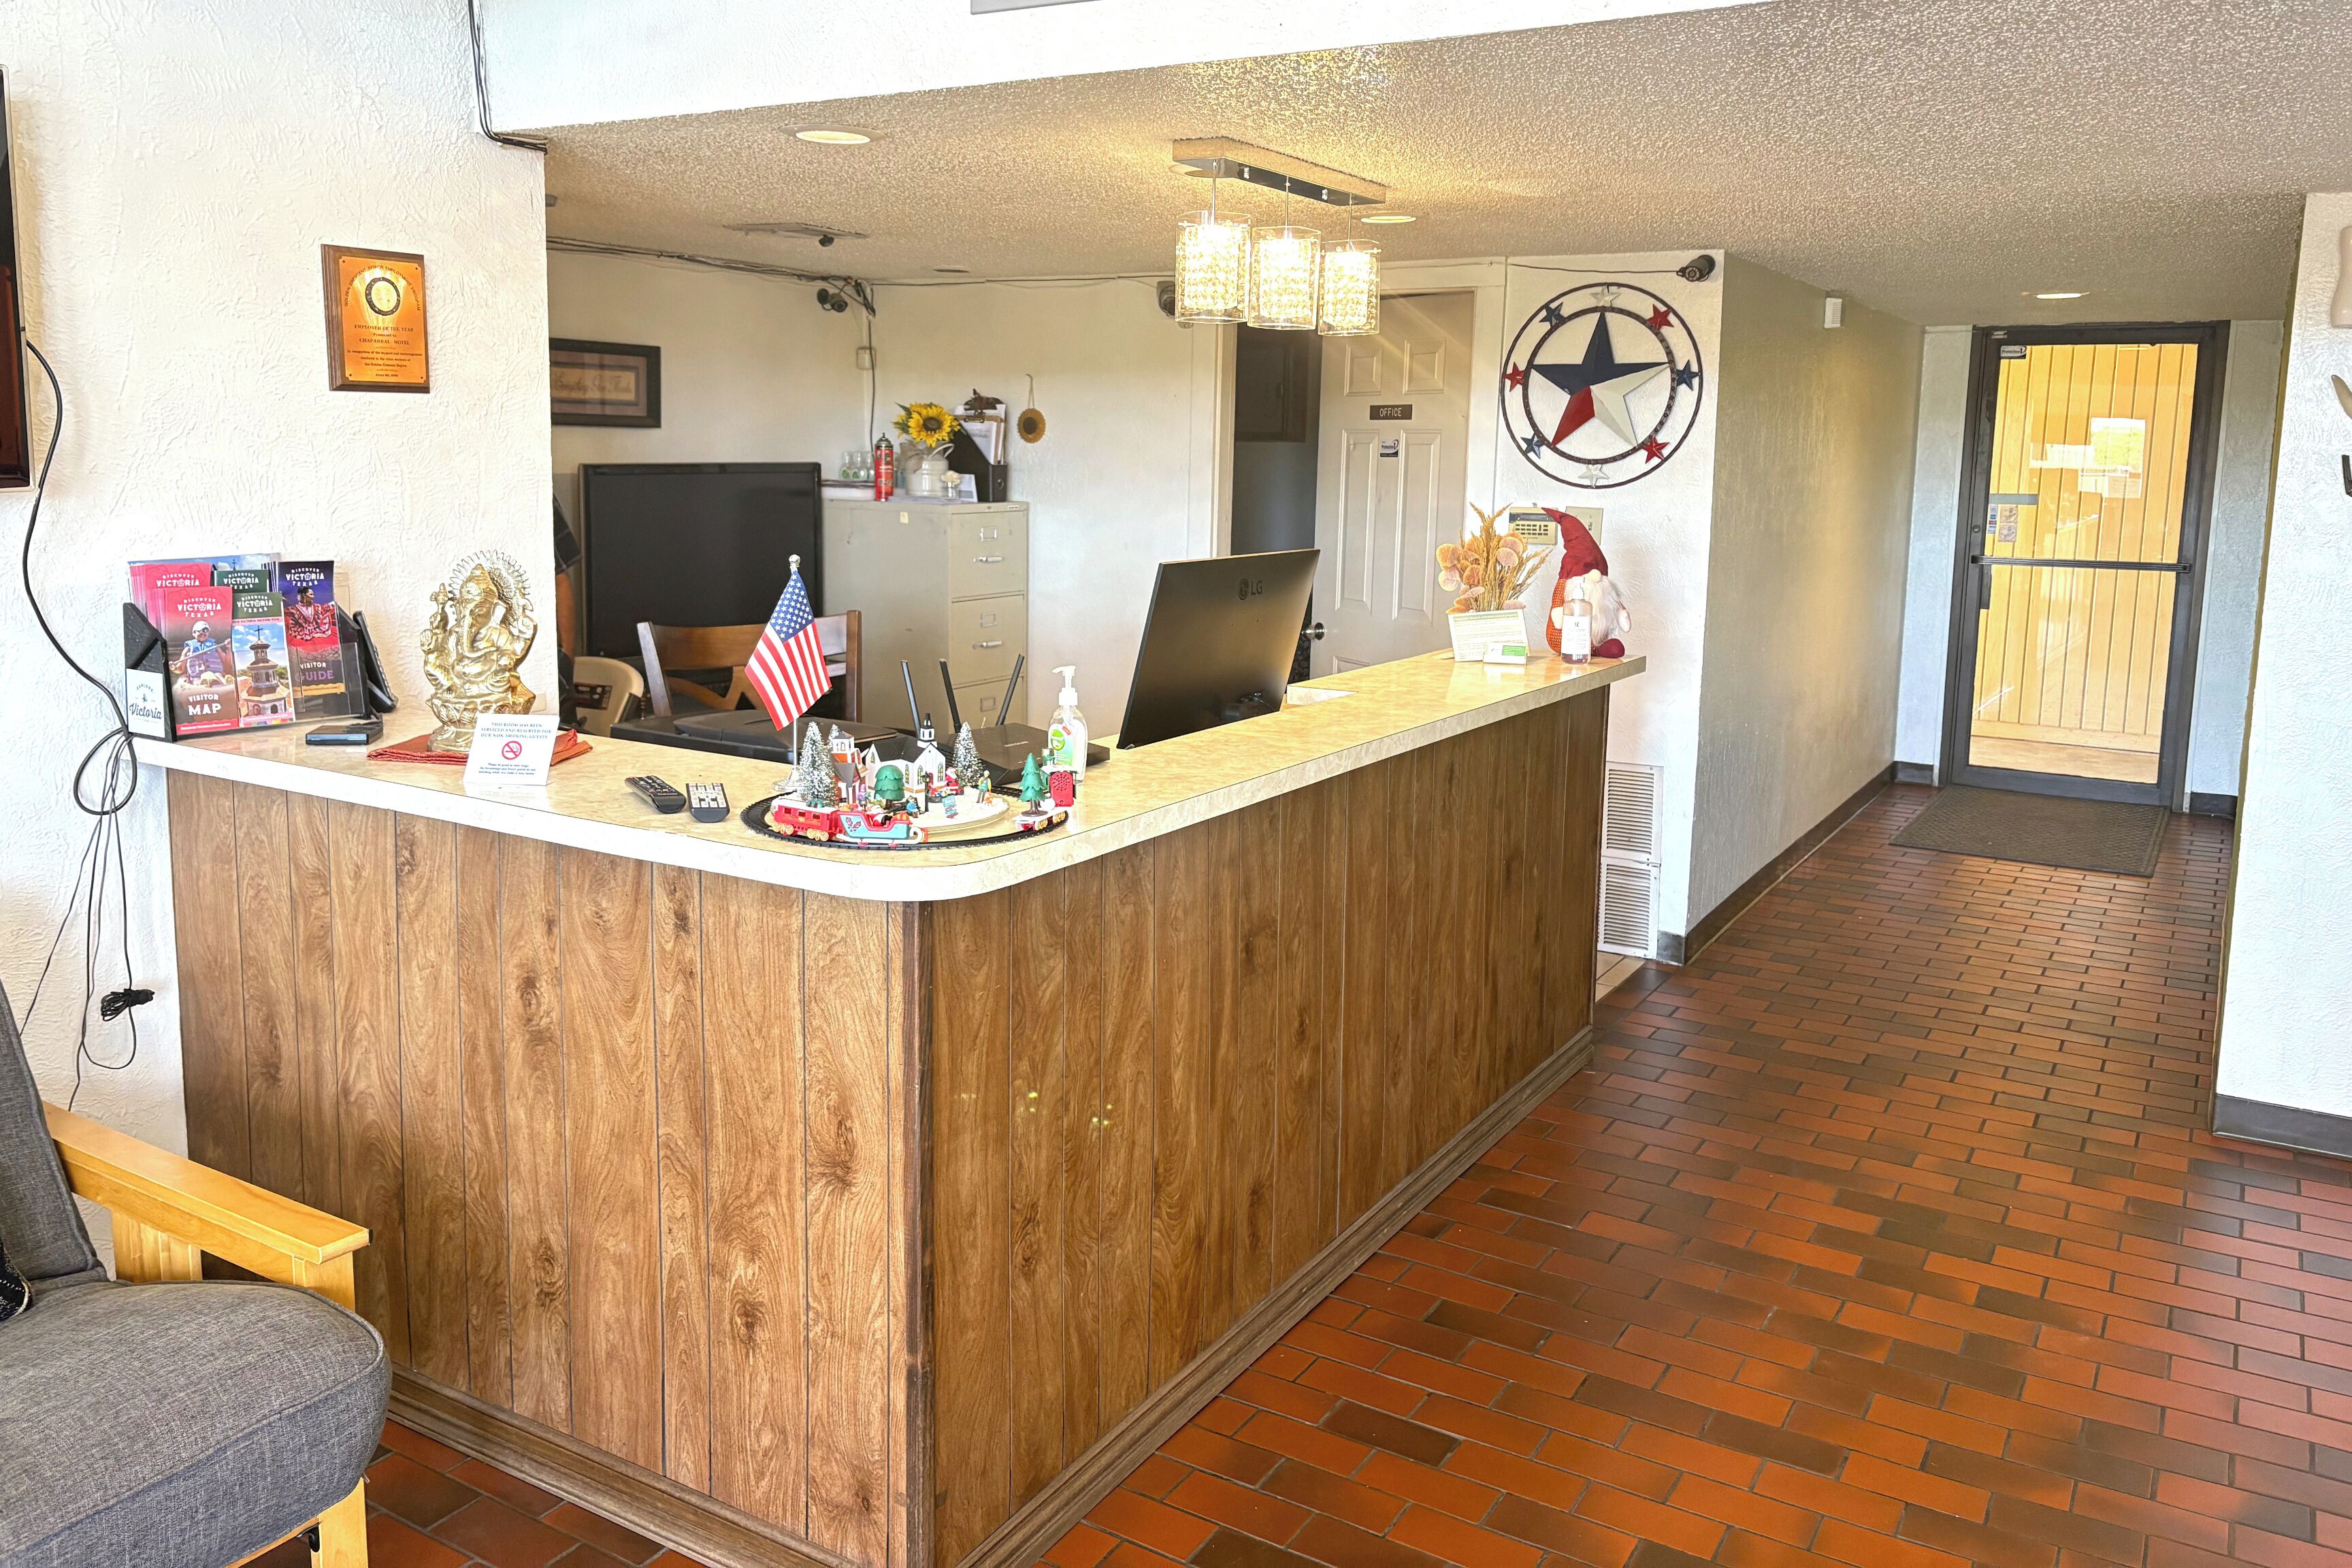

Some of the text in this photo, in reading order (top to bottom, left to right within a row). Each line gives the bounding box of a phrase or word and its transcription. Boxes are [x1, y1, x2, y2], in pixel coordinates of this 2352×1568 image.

[349, 267, 366, 286] CRESCENT
[385, 266, 412, 287] EMPLOYMENT
[410, 287, 421, 311] PROGRAM
[1379, 408, 1402, 417] OFFICE
[286, 572, 325, 581] VICTORIA
[156, 578, 200, 587] VICTORIA
[1251, 580, 1262, 595] LG
[178, 602, 222, 611] VICTORIA
[295, 670, 334, 681] GUIDE
[188, 693, 219, 702] VISITOR
[129, 702, 163, 720] Victoria
[188, 703, 222, 716] MAP
